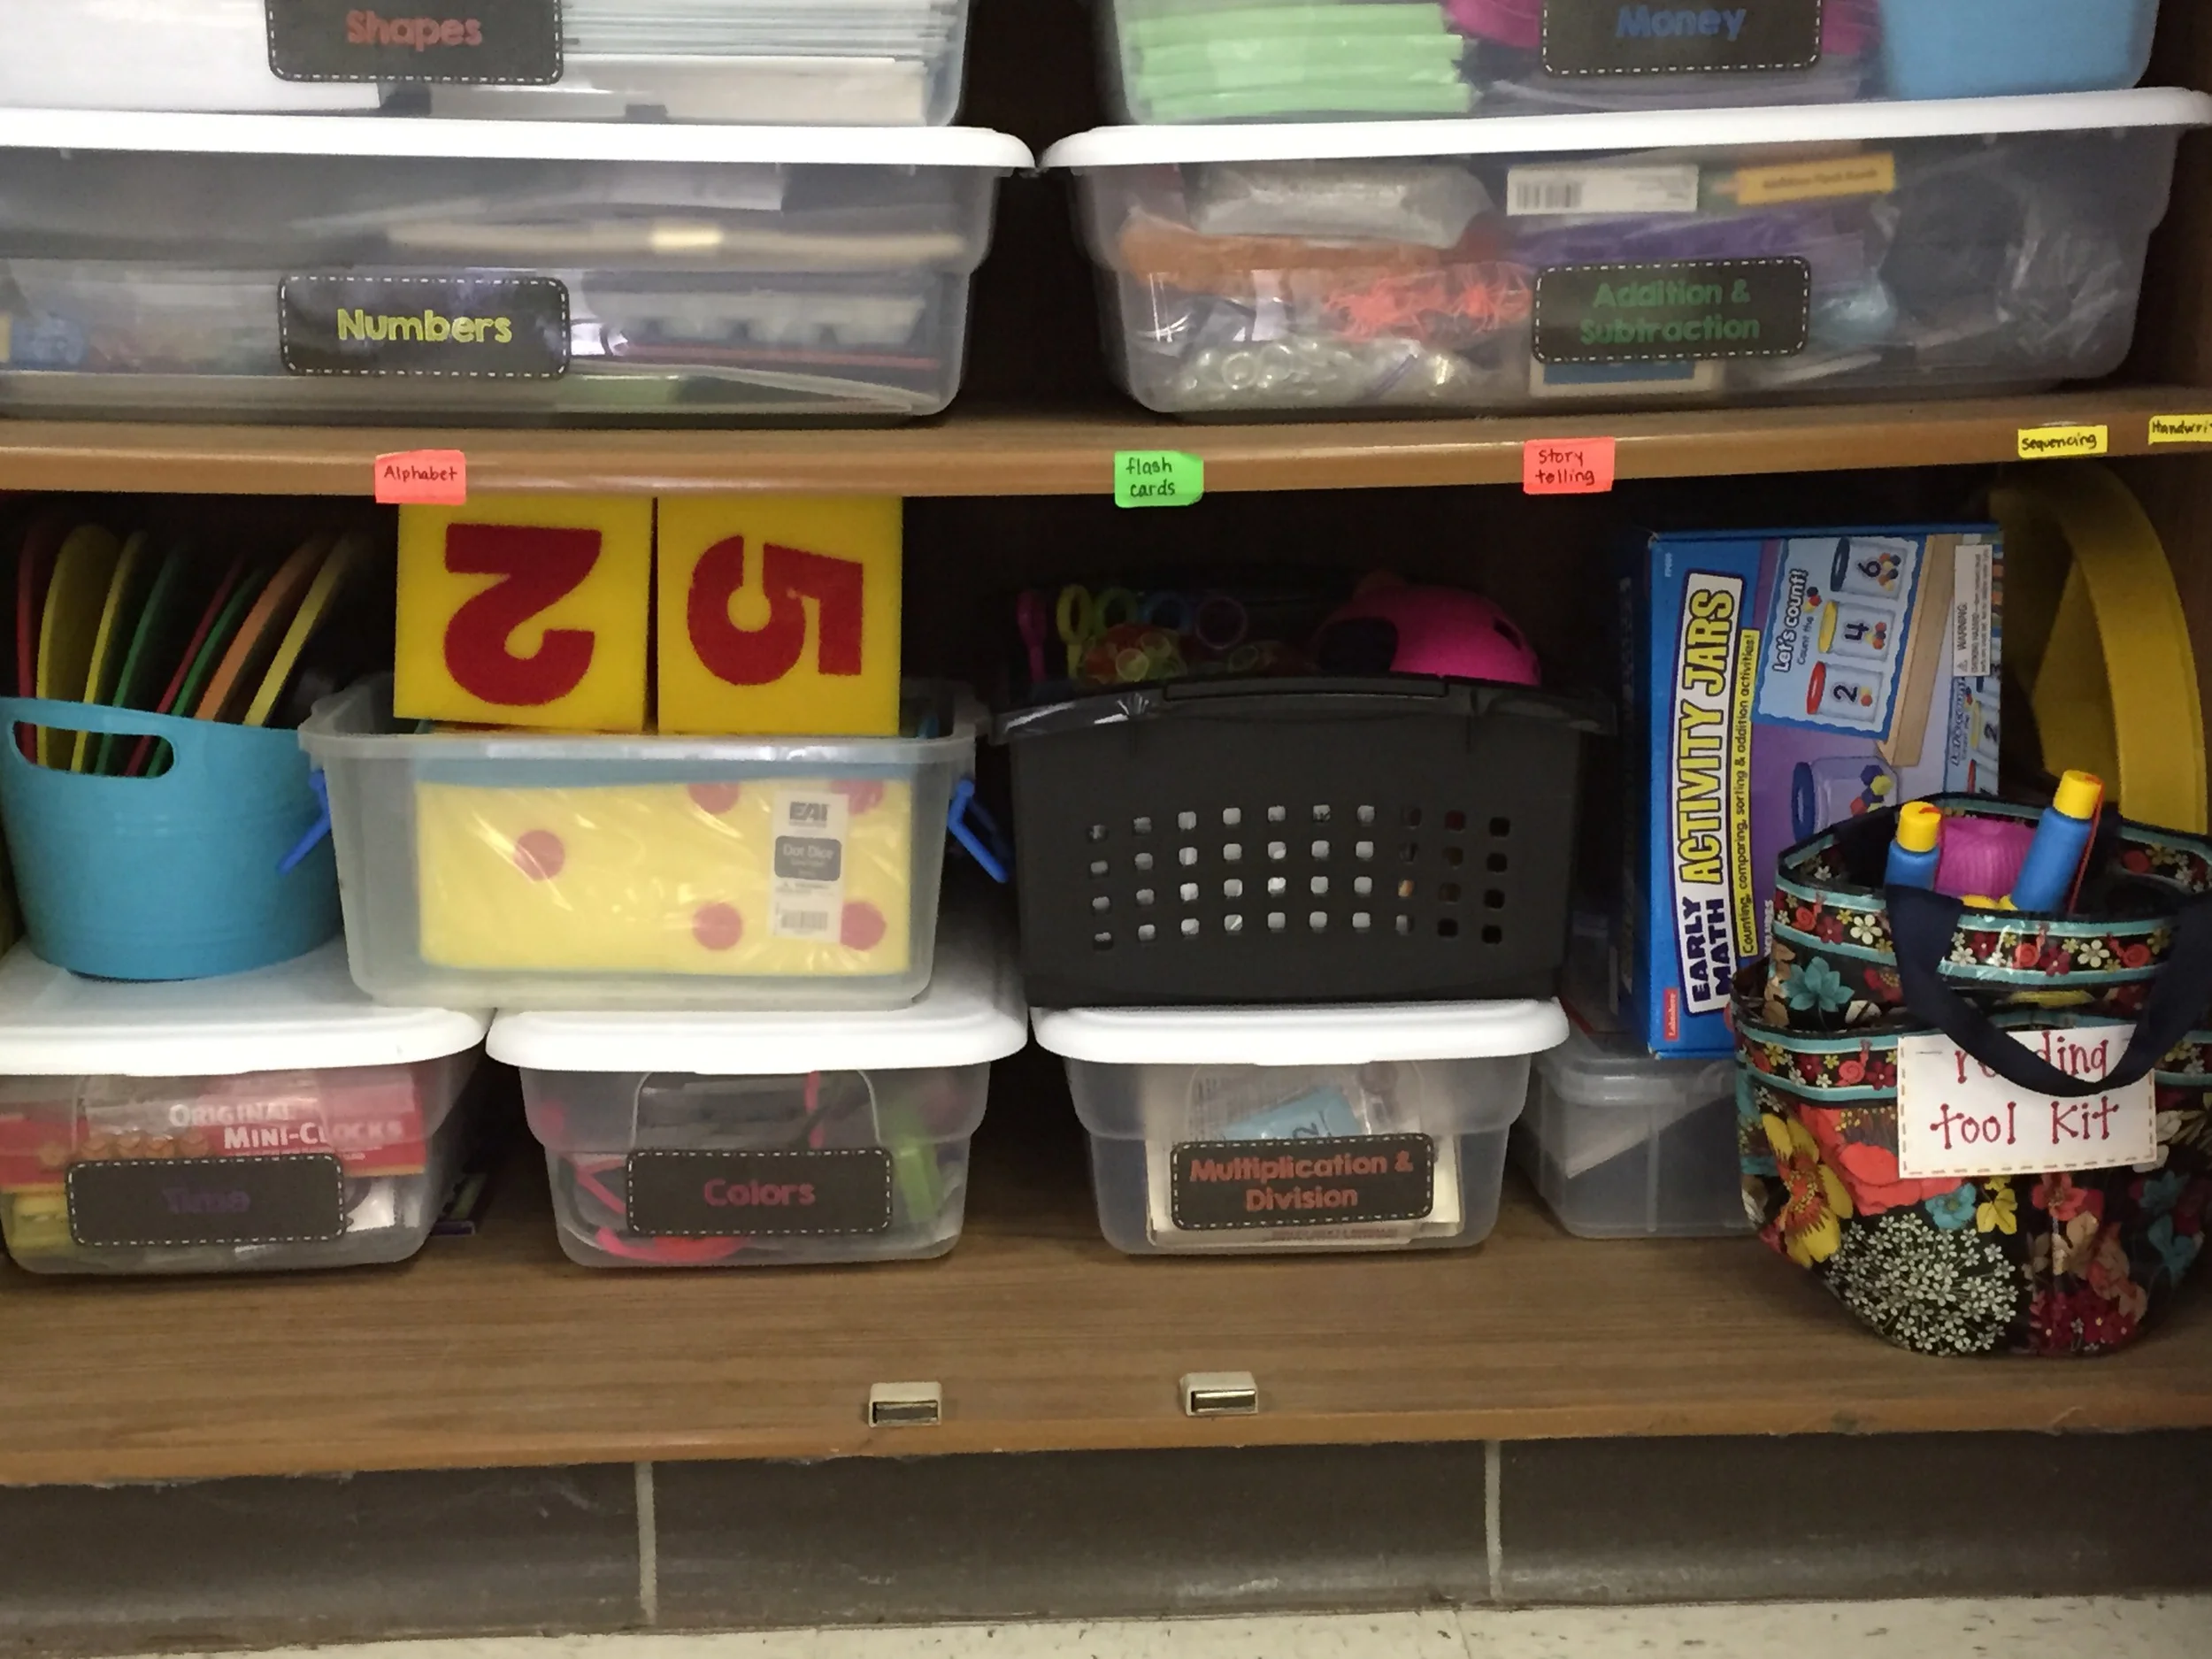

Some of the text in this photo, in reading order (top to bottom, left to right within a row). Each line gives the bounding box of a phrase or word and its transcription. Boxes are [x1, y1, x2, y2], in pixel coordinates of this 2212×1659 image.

[345, 12, 483, 49] Shapes
[1616, 4, 1747, 41] Money
[1593, 280, 1750, 309] Addition &
[336, 309, 513, 344] Numbers
[1579, 315, 1760, 346] Subtraction
[2022, 434, 2097, 452] Sequencing
[384, 465, 458, 482] Alphabet
[1125, 457, 1173, 475] flash
[1535, 469, 1595, 487] telling
[1130, 478, 1176, 497] cards
[1858, 561, 1881, 578] 6
[445, 523, 603, 706] 2
[687, 534, 864, 687] 5
[1772, 569, 1807, 672] Let's count!
[1844, 622, 1870, 641] 4
[1833, 684, 1857, 703] 2
[1677, 588, 1734, 886] ACTIVITY JARS
[1733, 634, 1755, 955] Counting, comparing, sorting & addition activities!
[1682, 895, 1711, 1002] EARLY
[1705, 898, 1732, 996] MATH
[169, 1103, 291, 1128] ORIGINAL
[1930, 1102, 2016, 1149] tool
[224, 1120, 403, 1149] MINI-CLOCKS
[1189, 1150, 1414, 1185] Multiplication &
[161, 1187, 251, 1215] Time
[703, 1179, 817, 1207] Colors
[1246, 1187, 1359, 1213] Division
